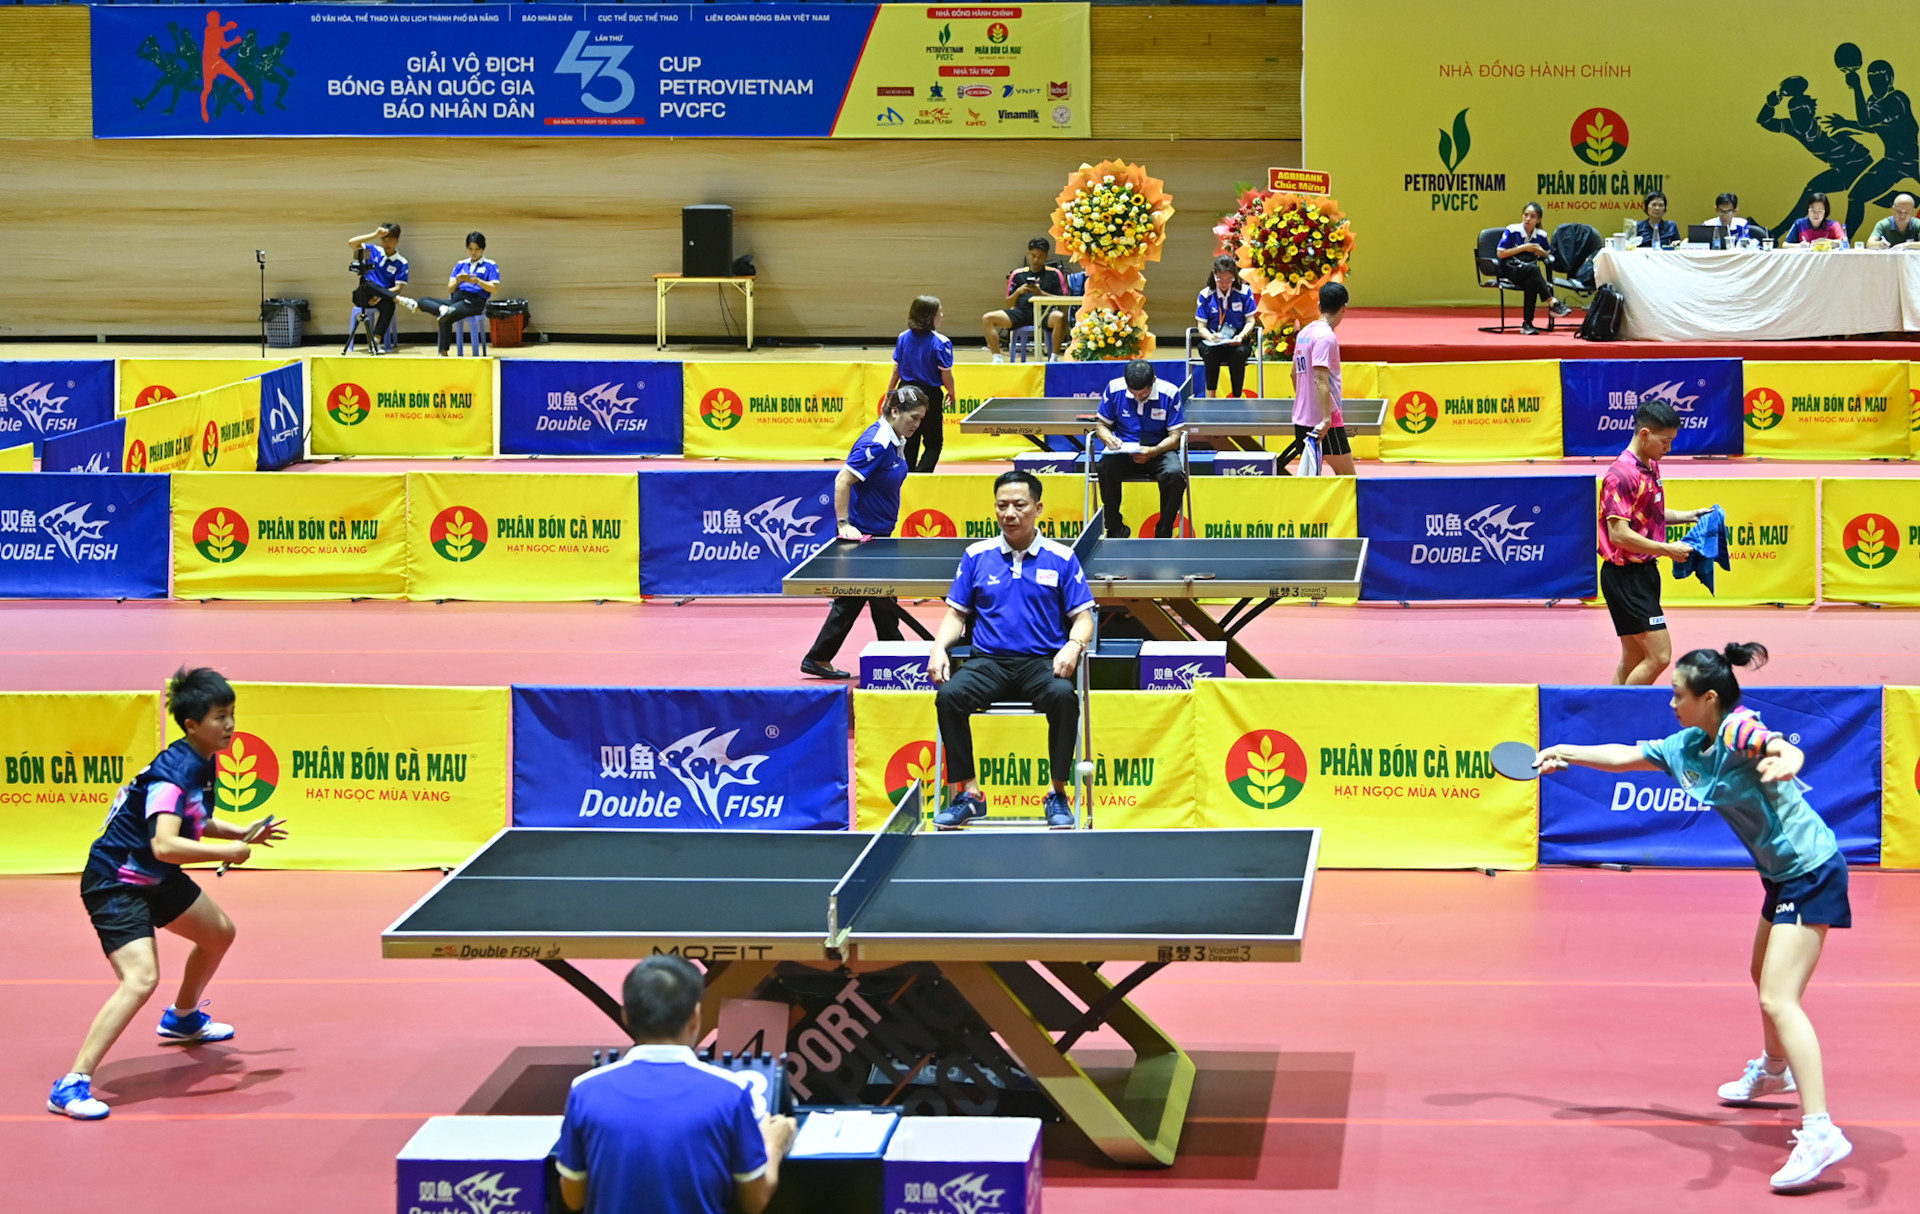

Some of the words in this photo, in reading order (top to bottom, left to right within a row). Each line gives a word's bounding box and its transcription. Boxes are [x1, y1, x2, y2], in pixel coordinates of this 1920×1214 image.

[390, 13, 399, 22] VÀ
[428, 13, 451, 22] THÀNH
[521, 13, 536, 22] BÁO
[598, 15, 612, 23] CỤC
[629, 15, 643, 23] DỤC
[749, 13, 772, 21] BÓNG
[774, 13, 791, 21] BÀN
[407, 51, 445, 73] GIẢI
[452, 52, 480, 73] VÔ
[485, 57, 534, 77] ĐỊCH
[553, 30, 635, 114] 43
[660, 56, 701, 73] CUP
[1439, 61, 1473, 77] NHÀ
[1479, 59, 1525, 77] ĐỒNG
[1530, 61, 1576, 77] HÀNH
[1581, 61, 1631, 77] CHÍNH
[328, 75, 384, 96] BÓNG
[391, 75, 431, 96] BÀN
[438, 72, 495, 96] QUỐC
[501, 80, 535, 95] GIA
[660, 79, 813, 95] PETROVIETNAM
[383, 98, 424, 118] BÁO
[430, 98, 487, 118] NHÂN
[493, 98, 535, 118] DÂN
[660, 102, 726, 118] PVCFC
[998, 110, 1039, 119] Vinamilk
[1278, 171, 1323, 183] AGRIBANK
[1405, 174, 1506, 191] PETROVIETNAM
[1537, 170, 1575, 195] PHÂN
[1579, 170, 1607, 195] BÓN
[1611, 170, 1629, 195] CÀ
[1634, 174, 1663, 195] MAU
[1274, 180, 1297, 190] Chúc
[1299, 182, 1326, 194] Mừng
[1432, 194, 1479, 211] PVCFC
[1547, 202, 1564, 212] HẠT
[1567, 202, 1597, 211] NGỌC
[1600, 200, 1620, 210] MÙA
[1623, 200, 1645, 210] VÀN
[377, 389, 407, 409] PHÂN
[409, 389, 431, 409] BÓN
[433, 389, 448, 409] CÀ
[450, 392, 473, 409] MAU
[547, 391, 578, 411] 双魚
[750, 394, 777, 413] PHÂN
[781, 394, 801, 413] BÓN
[804, 394, 818, 413] CÀ
[822, 397, 843, 413] MAU
[1445, 395, 1474, 415] PHÂN
[1477, 395, 1498, 414] BÓN
[1501, 394, 1515, 413] CÀ
[1517, 396, 1541, 413] MAU
[1608, 390, 1638, 411] 双魚
[46, 418, 78, 431] FISH
[536, 415, 591, 431] Double
[614, 418, 648, 431] FISH
[1, 510, 37, 533] 双魚
[258, 516, 294, 540] PHÂN
[299, 515, 326, 540] BÓN
[328, 514, 348, 540] CÀ
[351, 520, 379, 540] MAU
[497, 515, 535, 539] PHÂN
[538, 514, 566, 540] BÓN
[569, 514, 589, 539] CÀ
[592, 519, 621, 540] MAU
[702, 510, 743, 535] 双魚
[1205, 520, 1242, 538] PHÂN
[1277, 519, 1295, 538] CÀ
[1425, 513, 1463, 537] 双魚
[1738, 522, 1755, 546] CÀ
[1760, 524, 1788, 545] MAU
[78, 543, 118, 561] FISH
[268, 546, 284, 556] HẠT
[286, 546, 316, 556] NGỌC
[317, 544, 339, 554] MÙA
[340, 544, 367, 554] VÀNG
[688, 541, 761, 562] Double
[1410, 543, 1482, 564] DOUBLE
[1505, 544, 1545, 562] FISH
[1750, 550, 1777, 560] VÀNG
[832, 586, 862, 595] Double
[863, 587, 882, 595] FISH
[6, 751, 45, 784] BÓN
[51, 751, 77, 784] CÀ
[83, 755, 124, 784] MAU
[292, 745, 345, 780] PHÂN
[351, 746, 389, 780] BÓN
[395, 747, 420, 781] CÀ
[427, 752, 467, 782] MAU
[600, 743, 656, 780] 双魚
[980, 752, 1031, 786] PHÂN
[1113, 757, 1154, 786] MAU
[1320, 742, 1373, 777] PHÂN
[1379, 744, 1417, 778] BÓN
[1424, 744, 1449, 778] CÀ
[1456, 750, 1496, 780] MAU
[36, 790, 66, 804] MÙA
[72, 790, 109, 804] VÀNG
[306, 788, 330, 802] HẠT
[334, 788, 375, 803] NGỌC
[379, 786, 408, 801] MÙA
[412, 787, 450, 802] VÀNG
[1335, 785, 1358, 797] HẠT
[1362, 785, 1404, 799] NGỌC
[1407, 783, 1437, 798] MÙA
[1442, 784, 1480, 799] VÀNG
[579, 789, 681, 818] Double
[724, 795, 784, 818] FISH
[993, 794, 1019, 808] HẠT
[1099, 793, 1137, 807] VÀNG
[461, 945, 508, 958] Double
[511, 946, 541, 958] FISH
[1194, 946, 1206, 961] 3
[788, 979, 881, 1100] PORT
